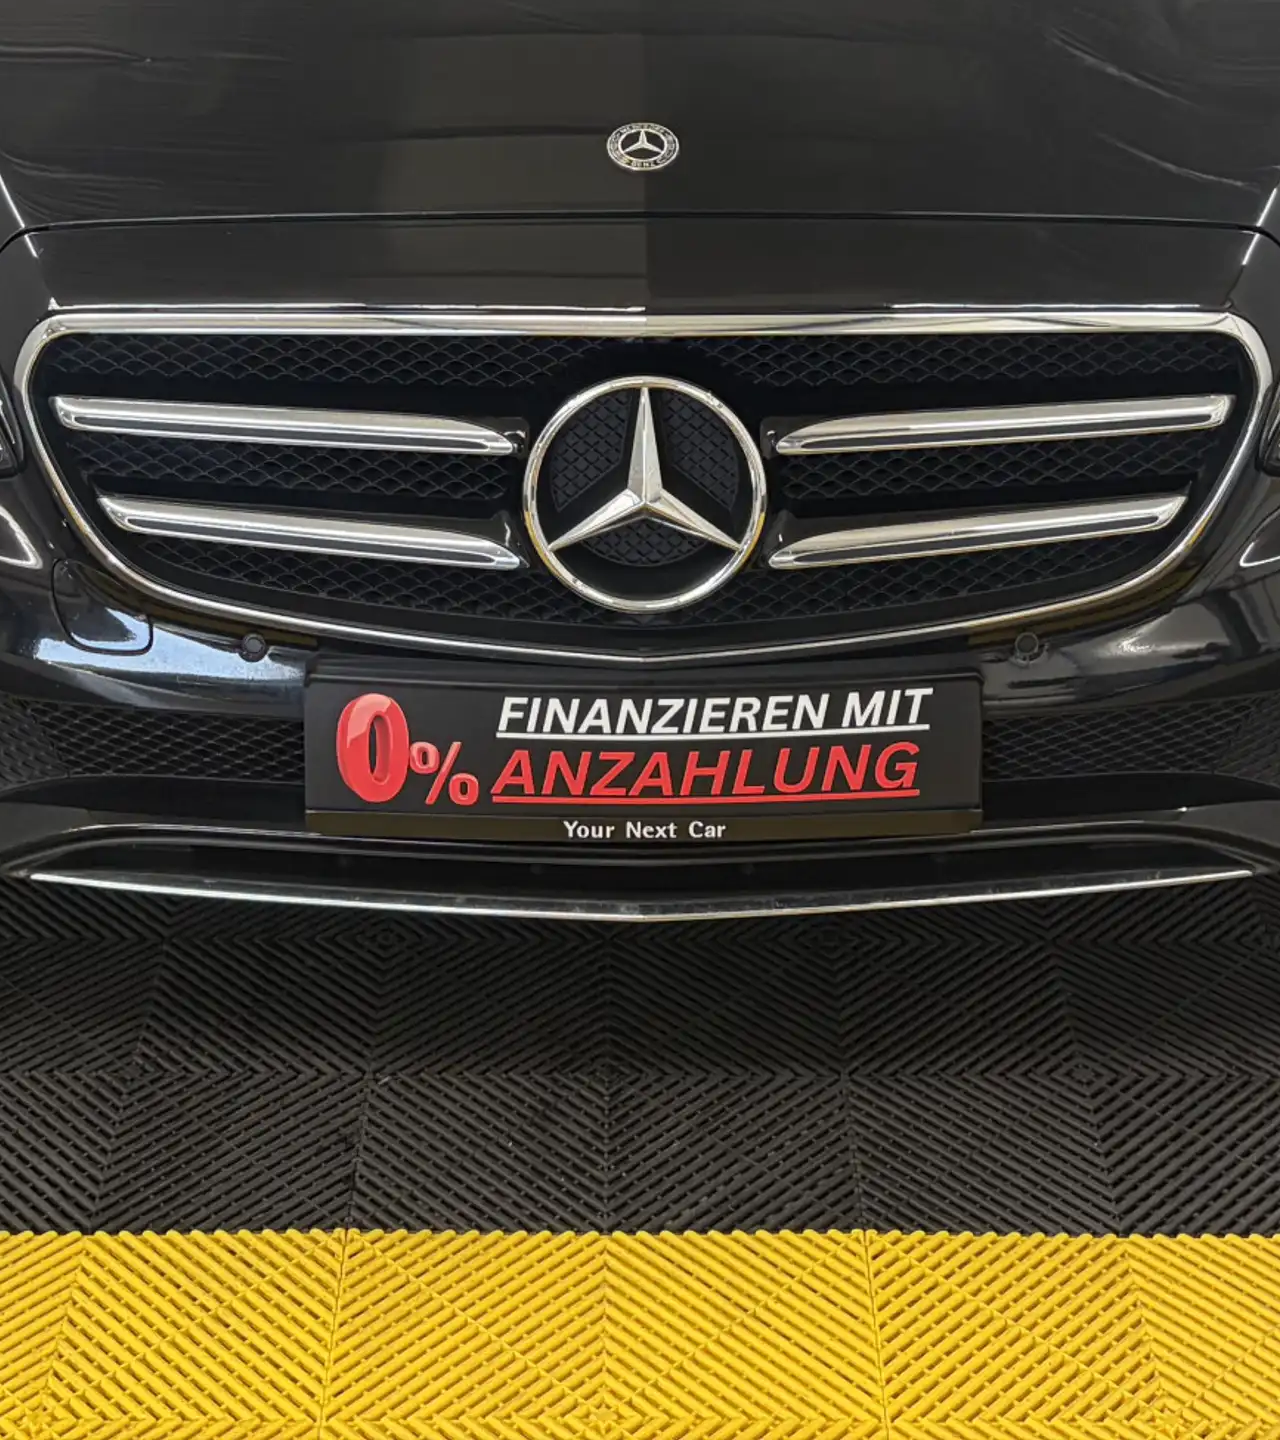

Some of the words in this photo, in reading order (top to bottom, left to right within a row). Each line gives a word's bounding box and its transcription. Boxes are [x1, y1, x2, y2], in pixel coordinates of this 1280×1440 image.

[497, 693, 830, 735] FINANZIEREN
[841, 687, 934, 728] MIT
[335, 693, 480, 806] 0%
[491, 741, 921, 797] ANZAHLUNG
[563, 820, 615, 839] Your
[625, 820, 678, 839] Next
[688, 820, 727, 839] Car
